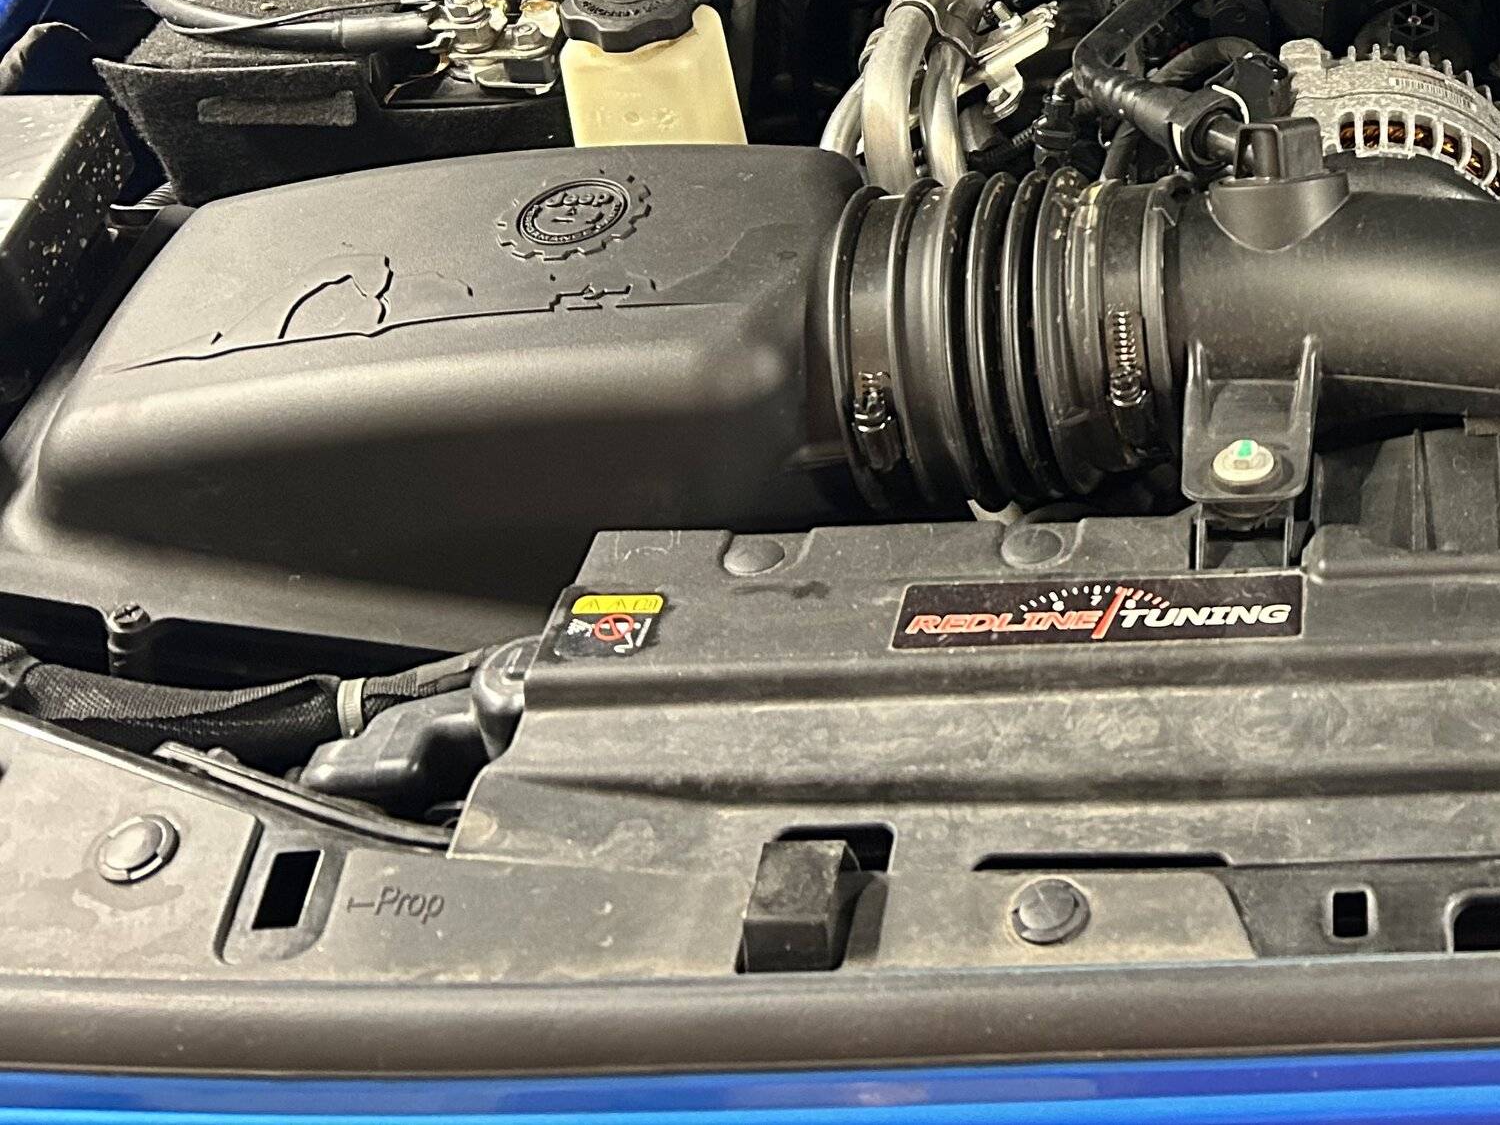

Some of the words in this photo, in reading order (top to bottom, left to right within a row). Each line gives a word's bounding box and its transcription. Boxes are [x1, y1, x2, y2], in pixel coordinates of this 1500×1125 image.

[546, 192, 614, 207] Jeep
[905, 611, 1103, 635] REDLINE
[1119, 604, 1292, 628] TUNING
[374, 885, 445, 925] Prop
